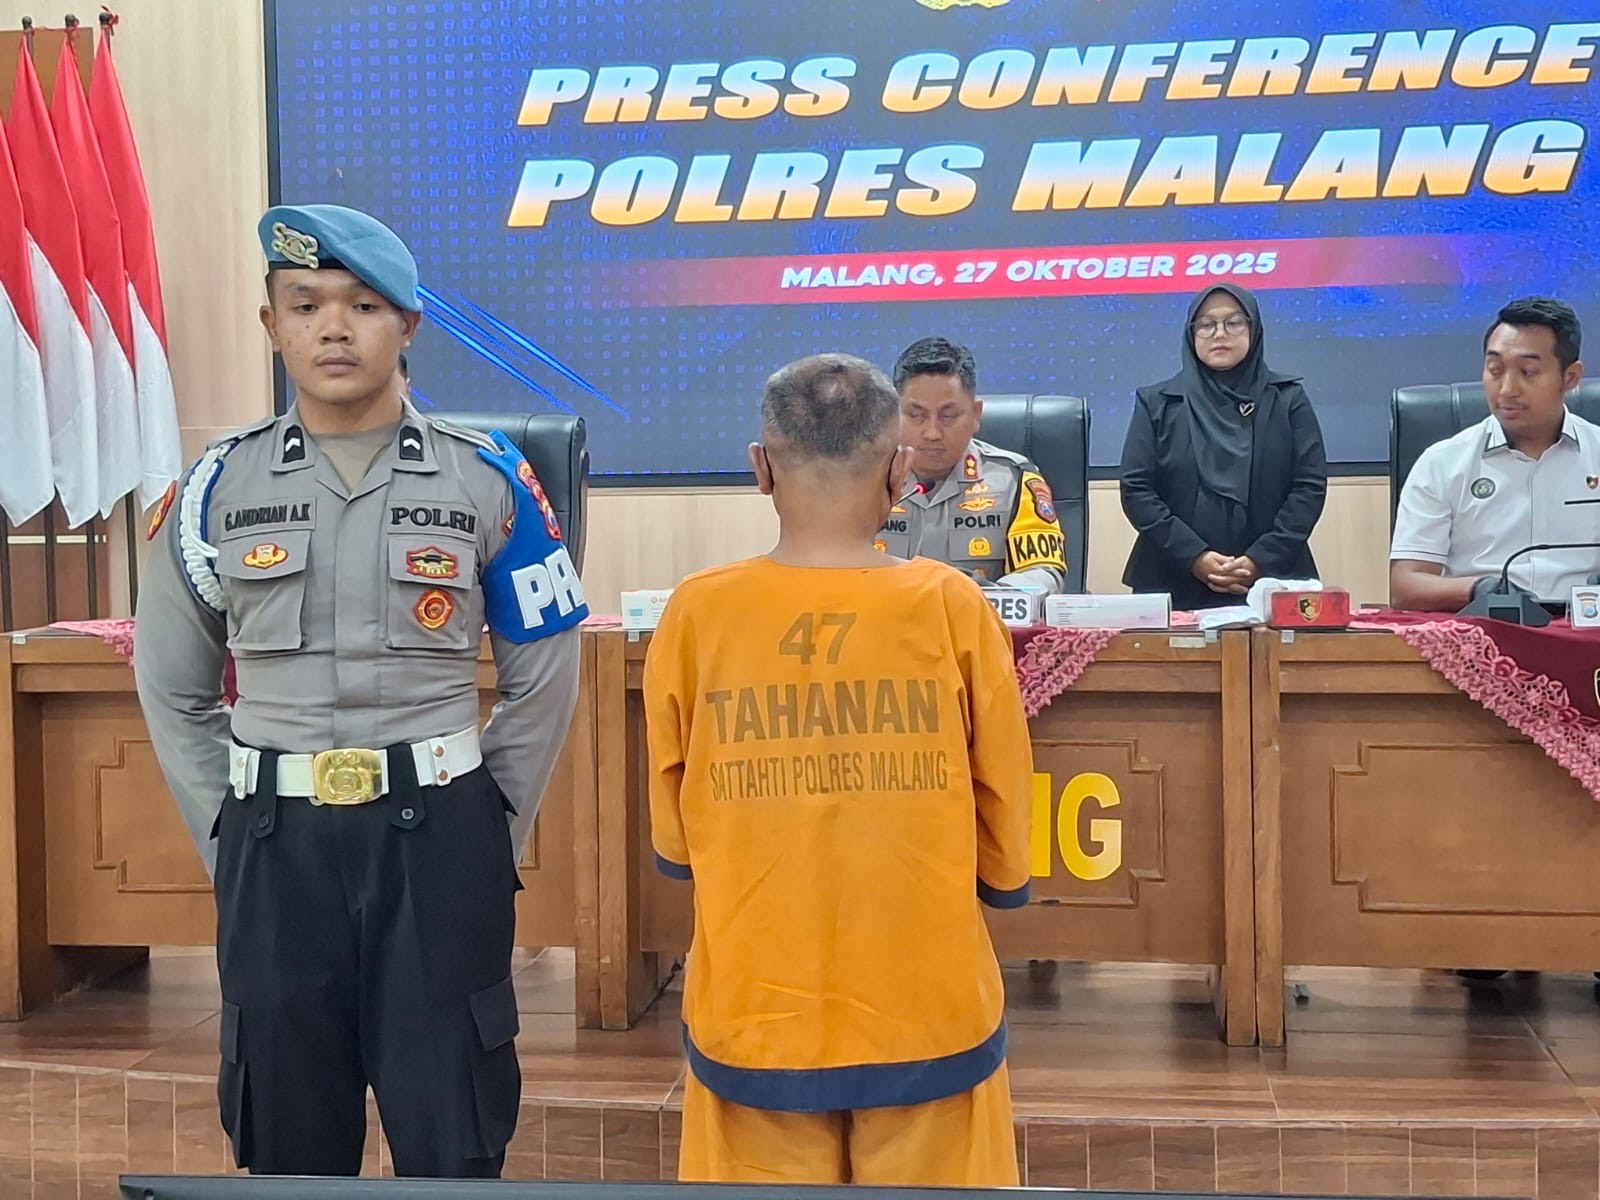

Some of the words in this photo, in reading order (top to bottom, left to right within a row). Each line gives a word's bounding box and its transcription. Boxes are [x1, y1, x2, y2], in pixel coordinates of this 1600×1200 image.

[516, 57, 857, 126] PRESS
[882, 22, 1600, 113] CONFERENCE
[506, 145, 985, 228] POLRES
[1011, 119, 1586, 212] MALANG
[780, 264, 943, 290] MALANG,
[954, 261, 997, 283] 27
[1006, 256, 1173, 282] OKTOBER
[1186, 252, 1278, 277] 2025
[390, 506, 476, 534] POLRI
[953, 514, 1001, 529] POLRI
[779, 612, 857, 665] 47
[705, 680, 940, 745] TAHANAN
[709, 756, 788, 801] SATTAHTI
[794, 752, 865, 797] POLRES
[870, 750, 949, 792] MALANG
